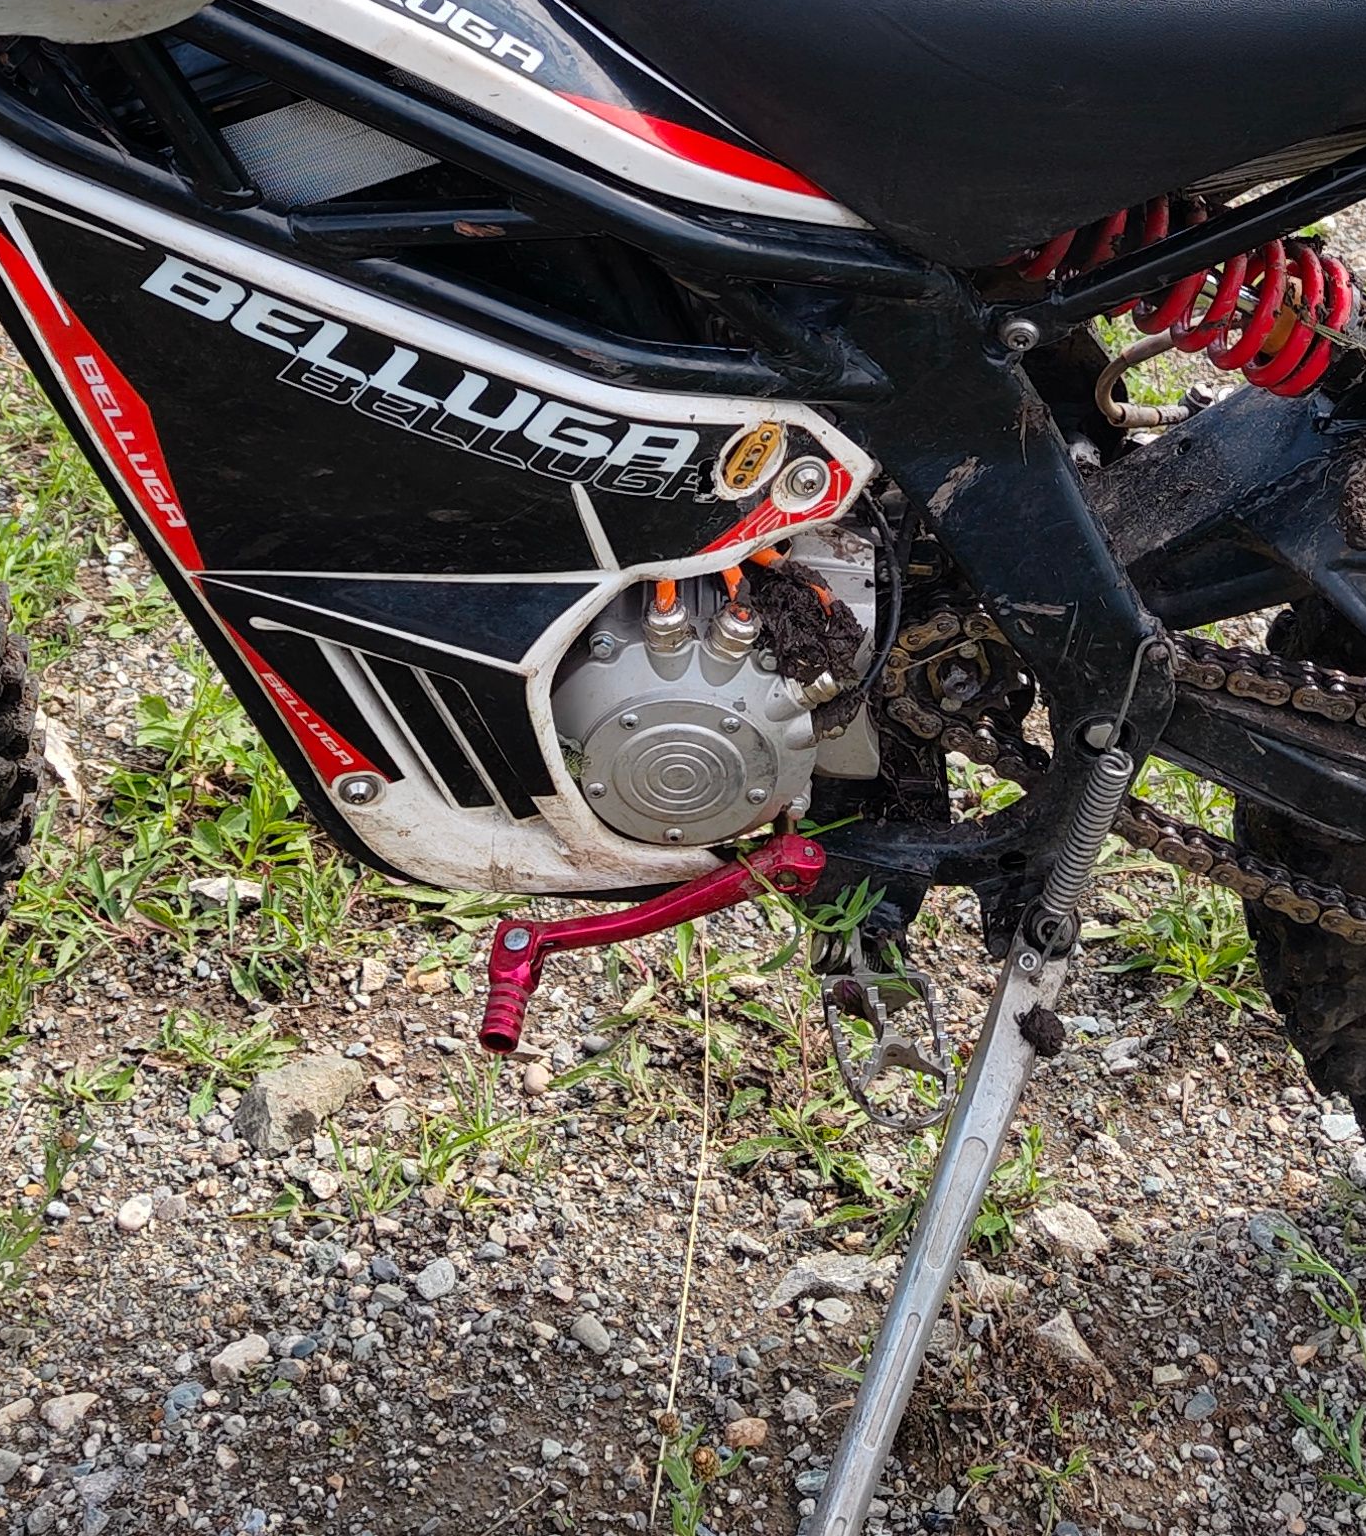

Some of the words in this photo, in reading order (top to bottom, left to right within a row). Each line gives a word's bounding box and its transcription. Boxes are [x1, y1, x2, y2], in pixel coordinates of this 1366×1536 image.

[73, 354, 188, 528] BELLUGA
[140, 255, 700, 473] BELLUGA
[260, 672, 355, 766] BELLUGA
